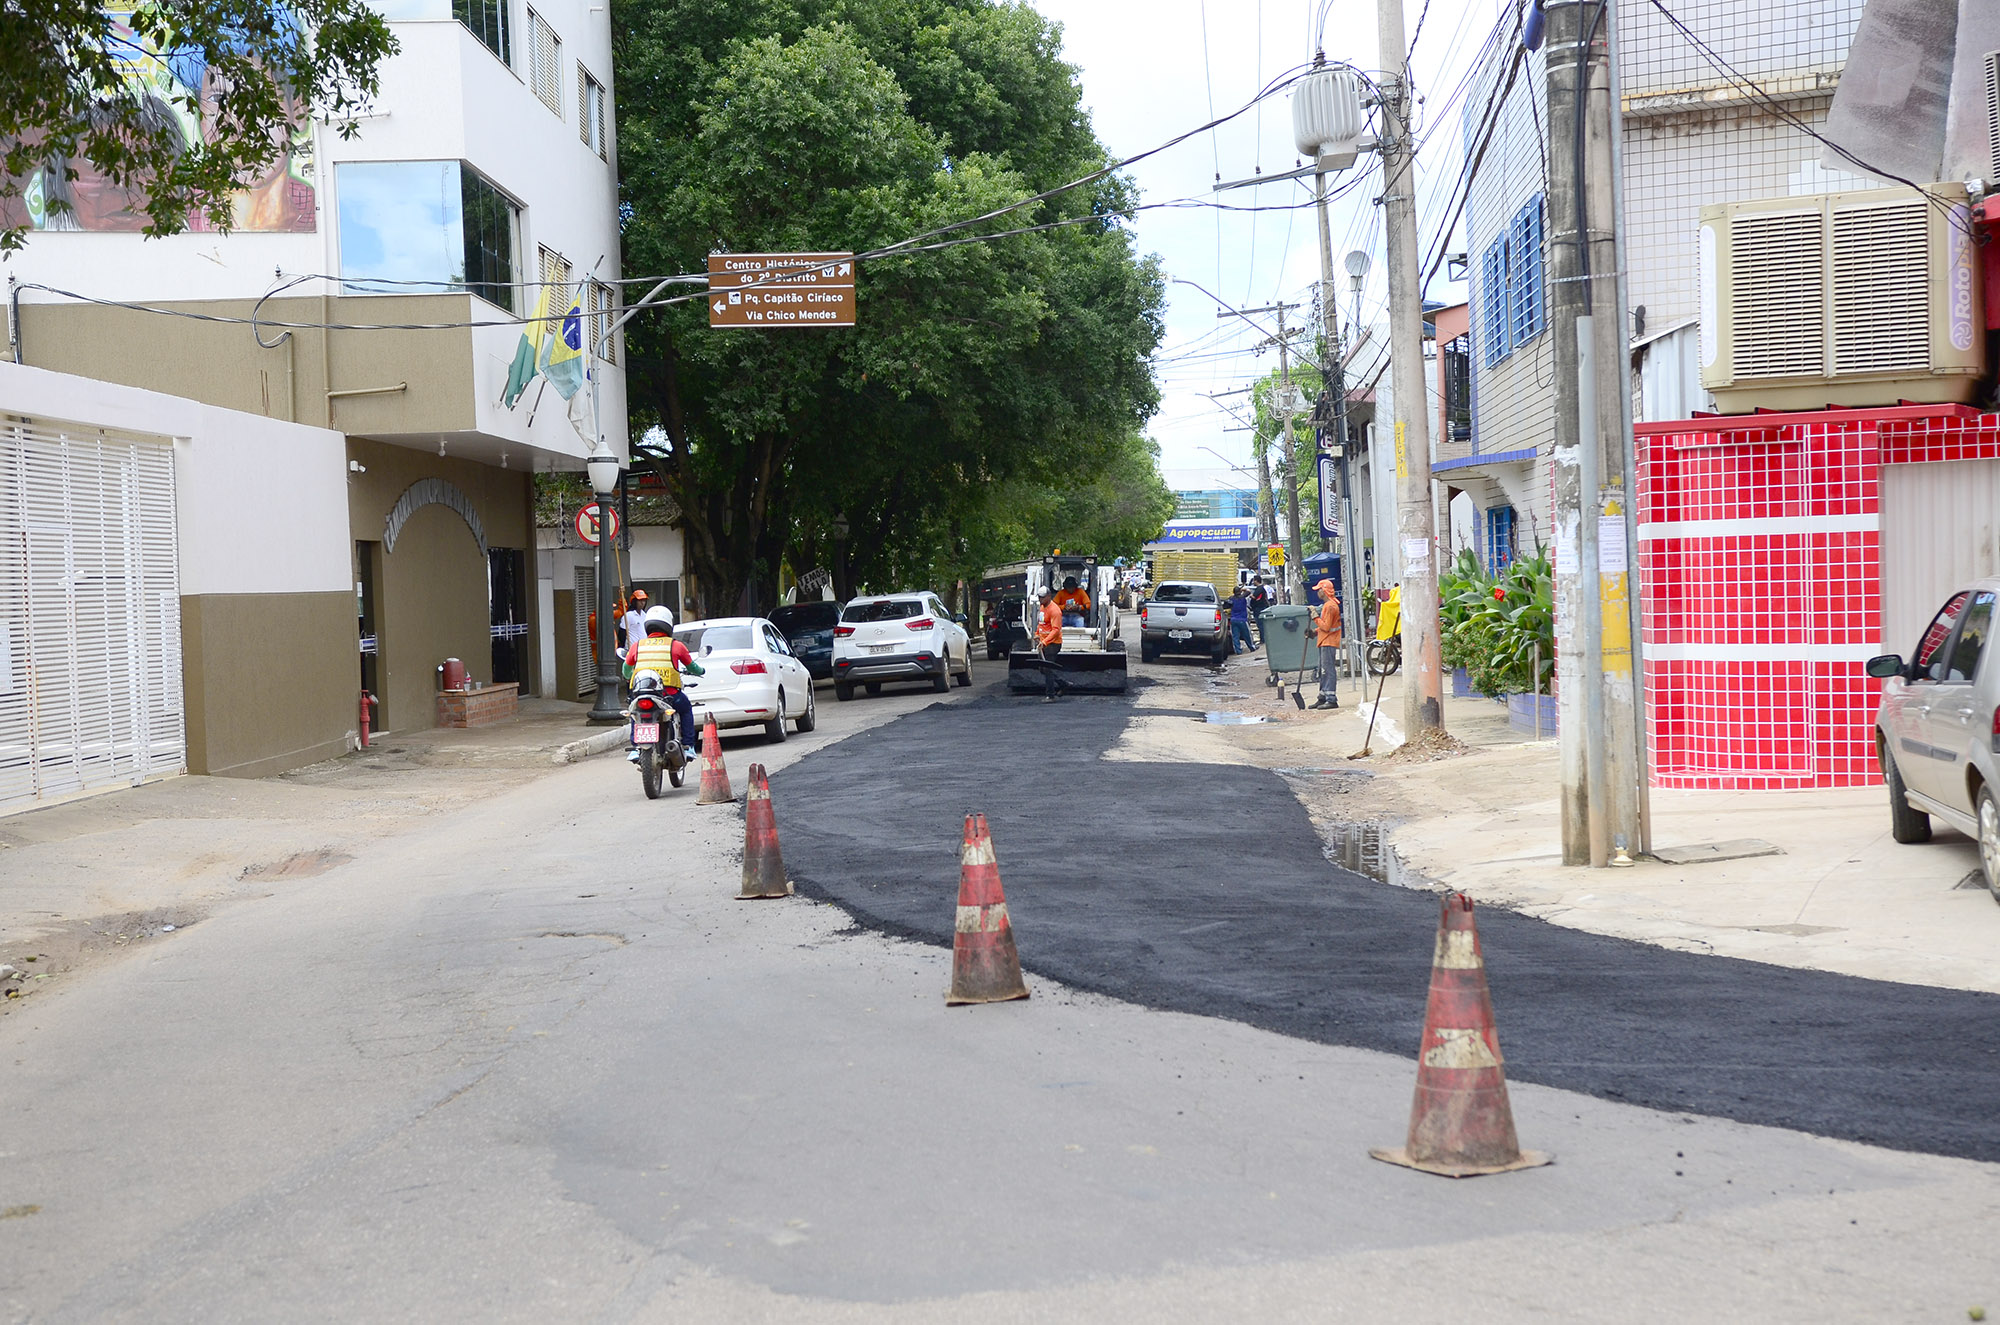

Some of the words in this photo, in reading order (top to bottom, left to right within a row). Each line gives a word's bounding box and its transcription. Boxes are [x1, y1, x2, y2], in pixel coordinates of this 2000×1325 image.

[725, 260, 761, 270] Centro
[740, 274, 753, 283] do
[775, 273, 817, 283] Distrito
[745, 294, 761, 304] Pq.
[764, 292, 803, 304] Capitão
[807, 292, 844, 303] Ciríaco
[746, 311, 763, 320] Via
[767, 310, 795, 320] Chico
[799, 309, 837, 320] Mendes
[1169, 528, 1241, 538] Agropecuária
[798, 567, 825, 586] TEMOS
